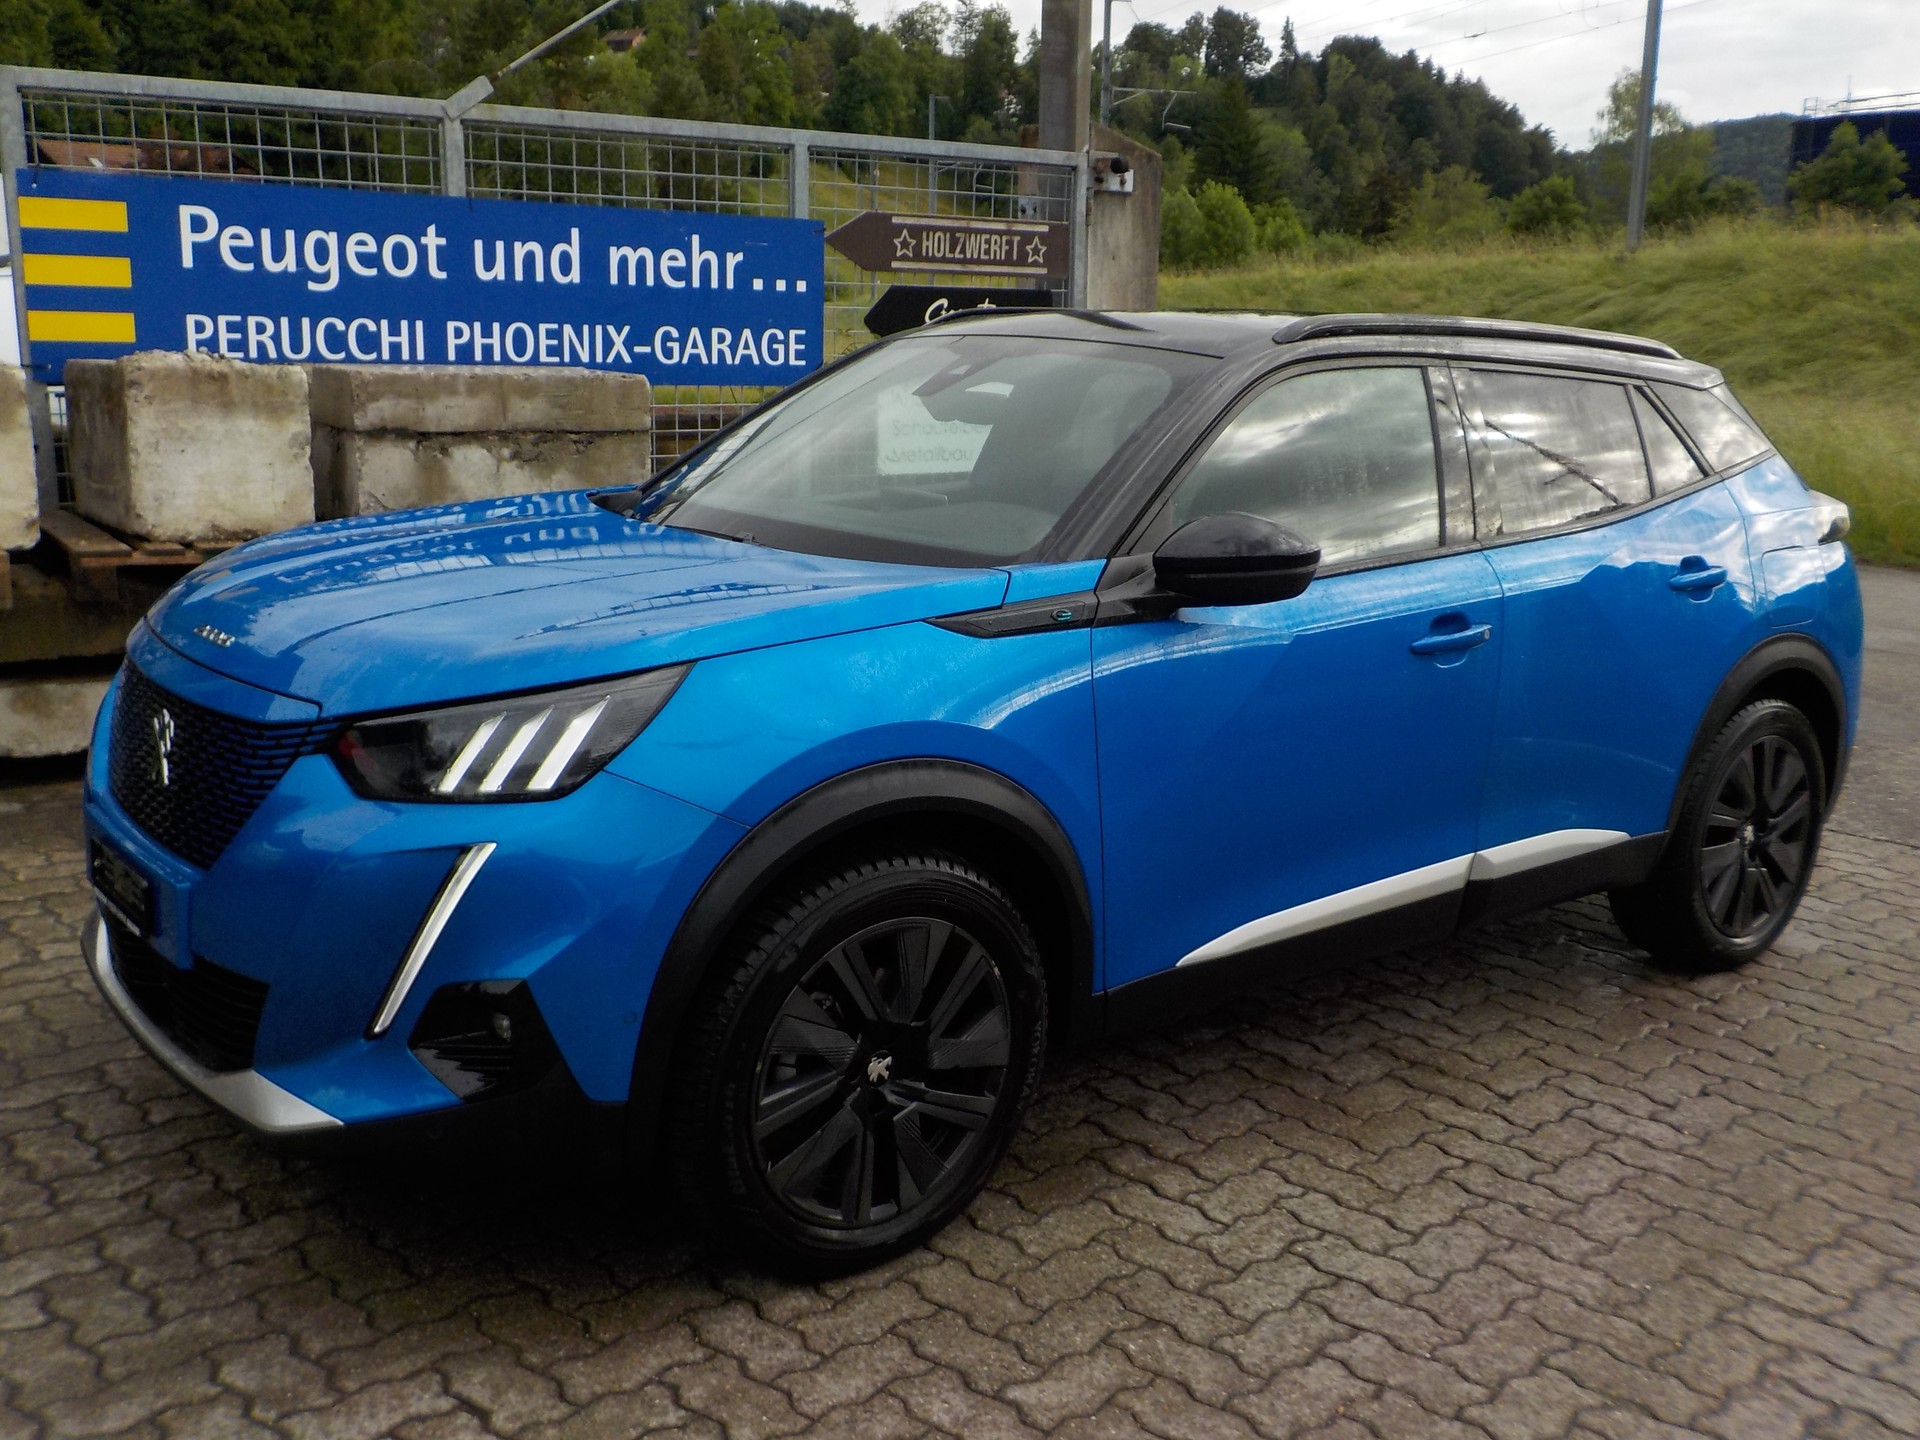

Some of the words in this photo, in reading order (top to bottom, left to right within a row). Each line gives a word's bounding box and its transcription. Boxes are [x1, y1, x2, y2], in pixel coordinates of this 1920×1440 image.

[179, 205, 447, 291] Peugeot
[474, 227, 581, 284] und
[608, 234, 807, 293] mehr...
[921, 231, 1021, 261] HOLZWERFT
[186, 314, 424, 360] PERUCCHI
[446, 321, 807, 366] PHOENIX-GARAGE
